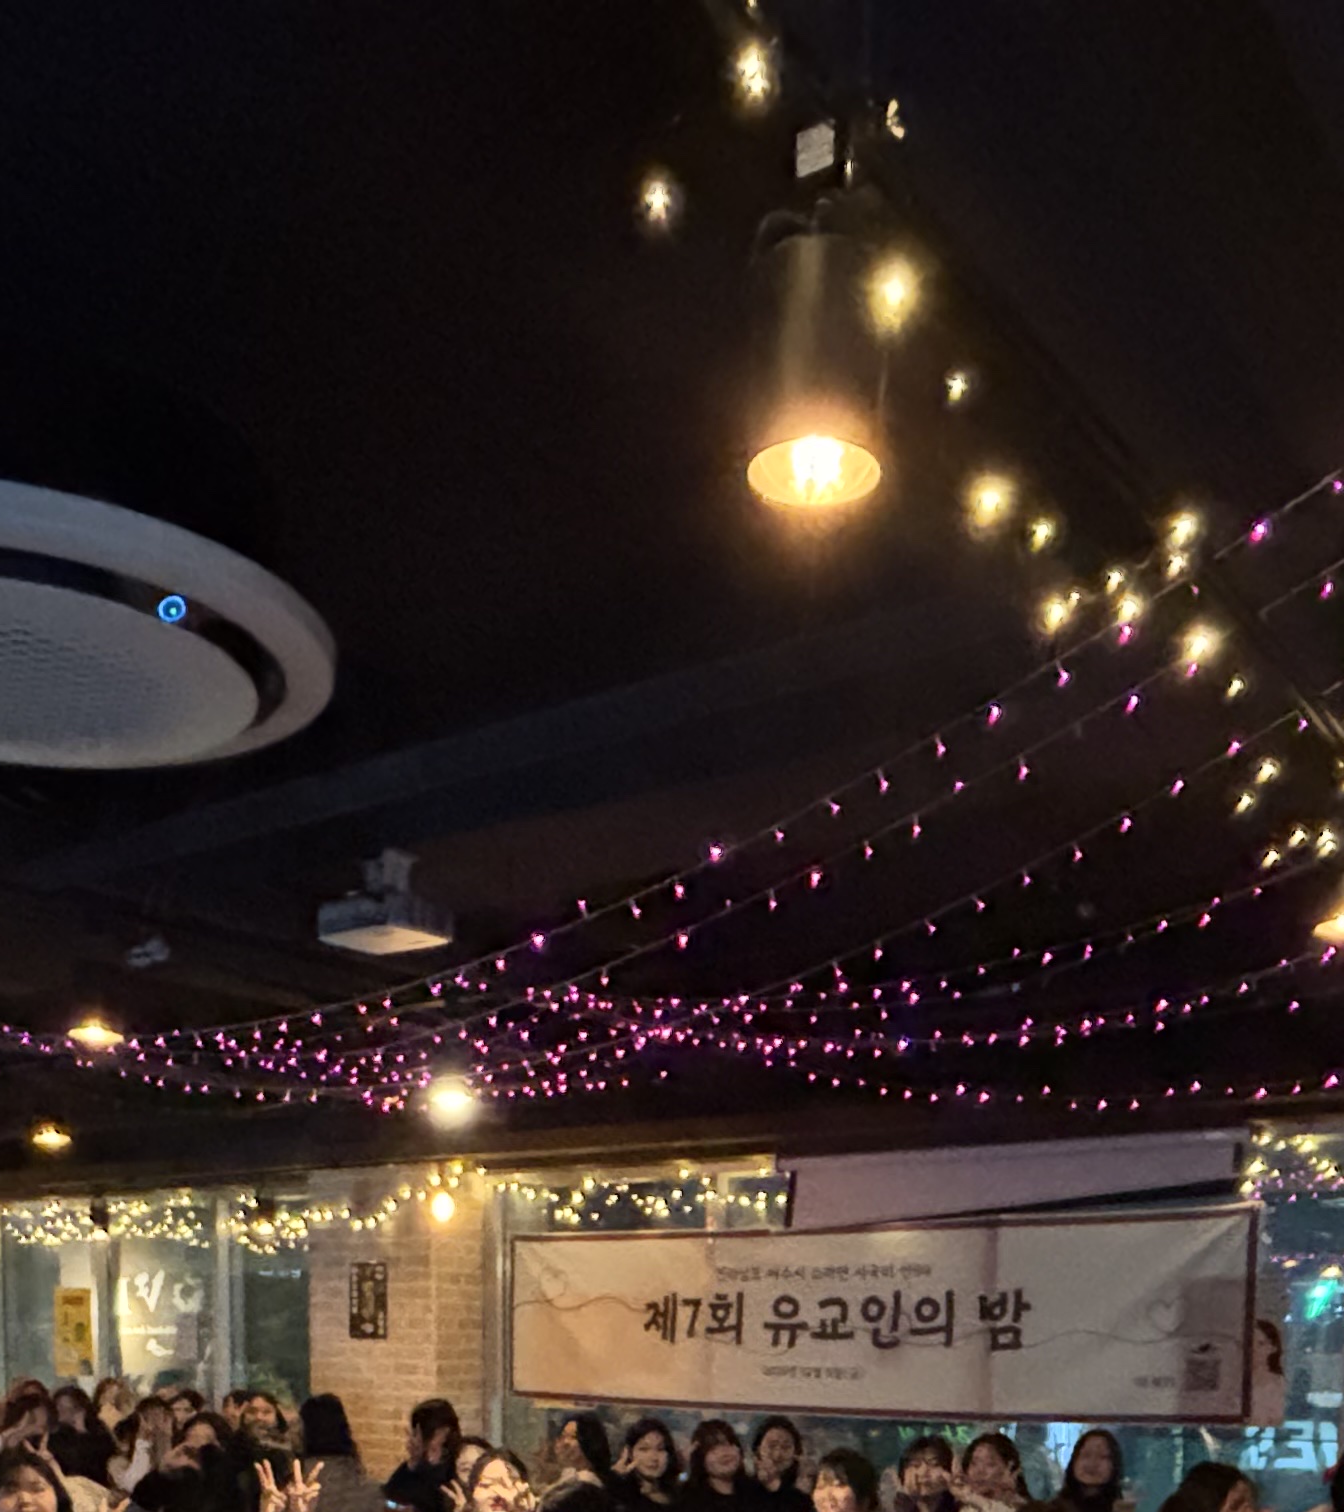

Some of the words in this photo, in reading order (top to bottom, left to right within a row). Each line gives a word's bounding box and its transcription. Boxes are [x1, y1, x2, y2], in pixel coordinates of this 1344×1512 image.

[644, 1290, 744, 1346] 제7회
[763, 1289, 954, 1350] 유교인의
[977, 1287, 1032, 1351] 밤
